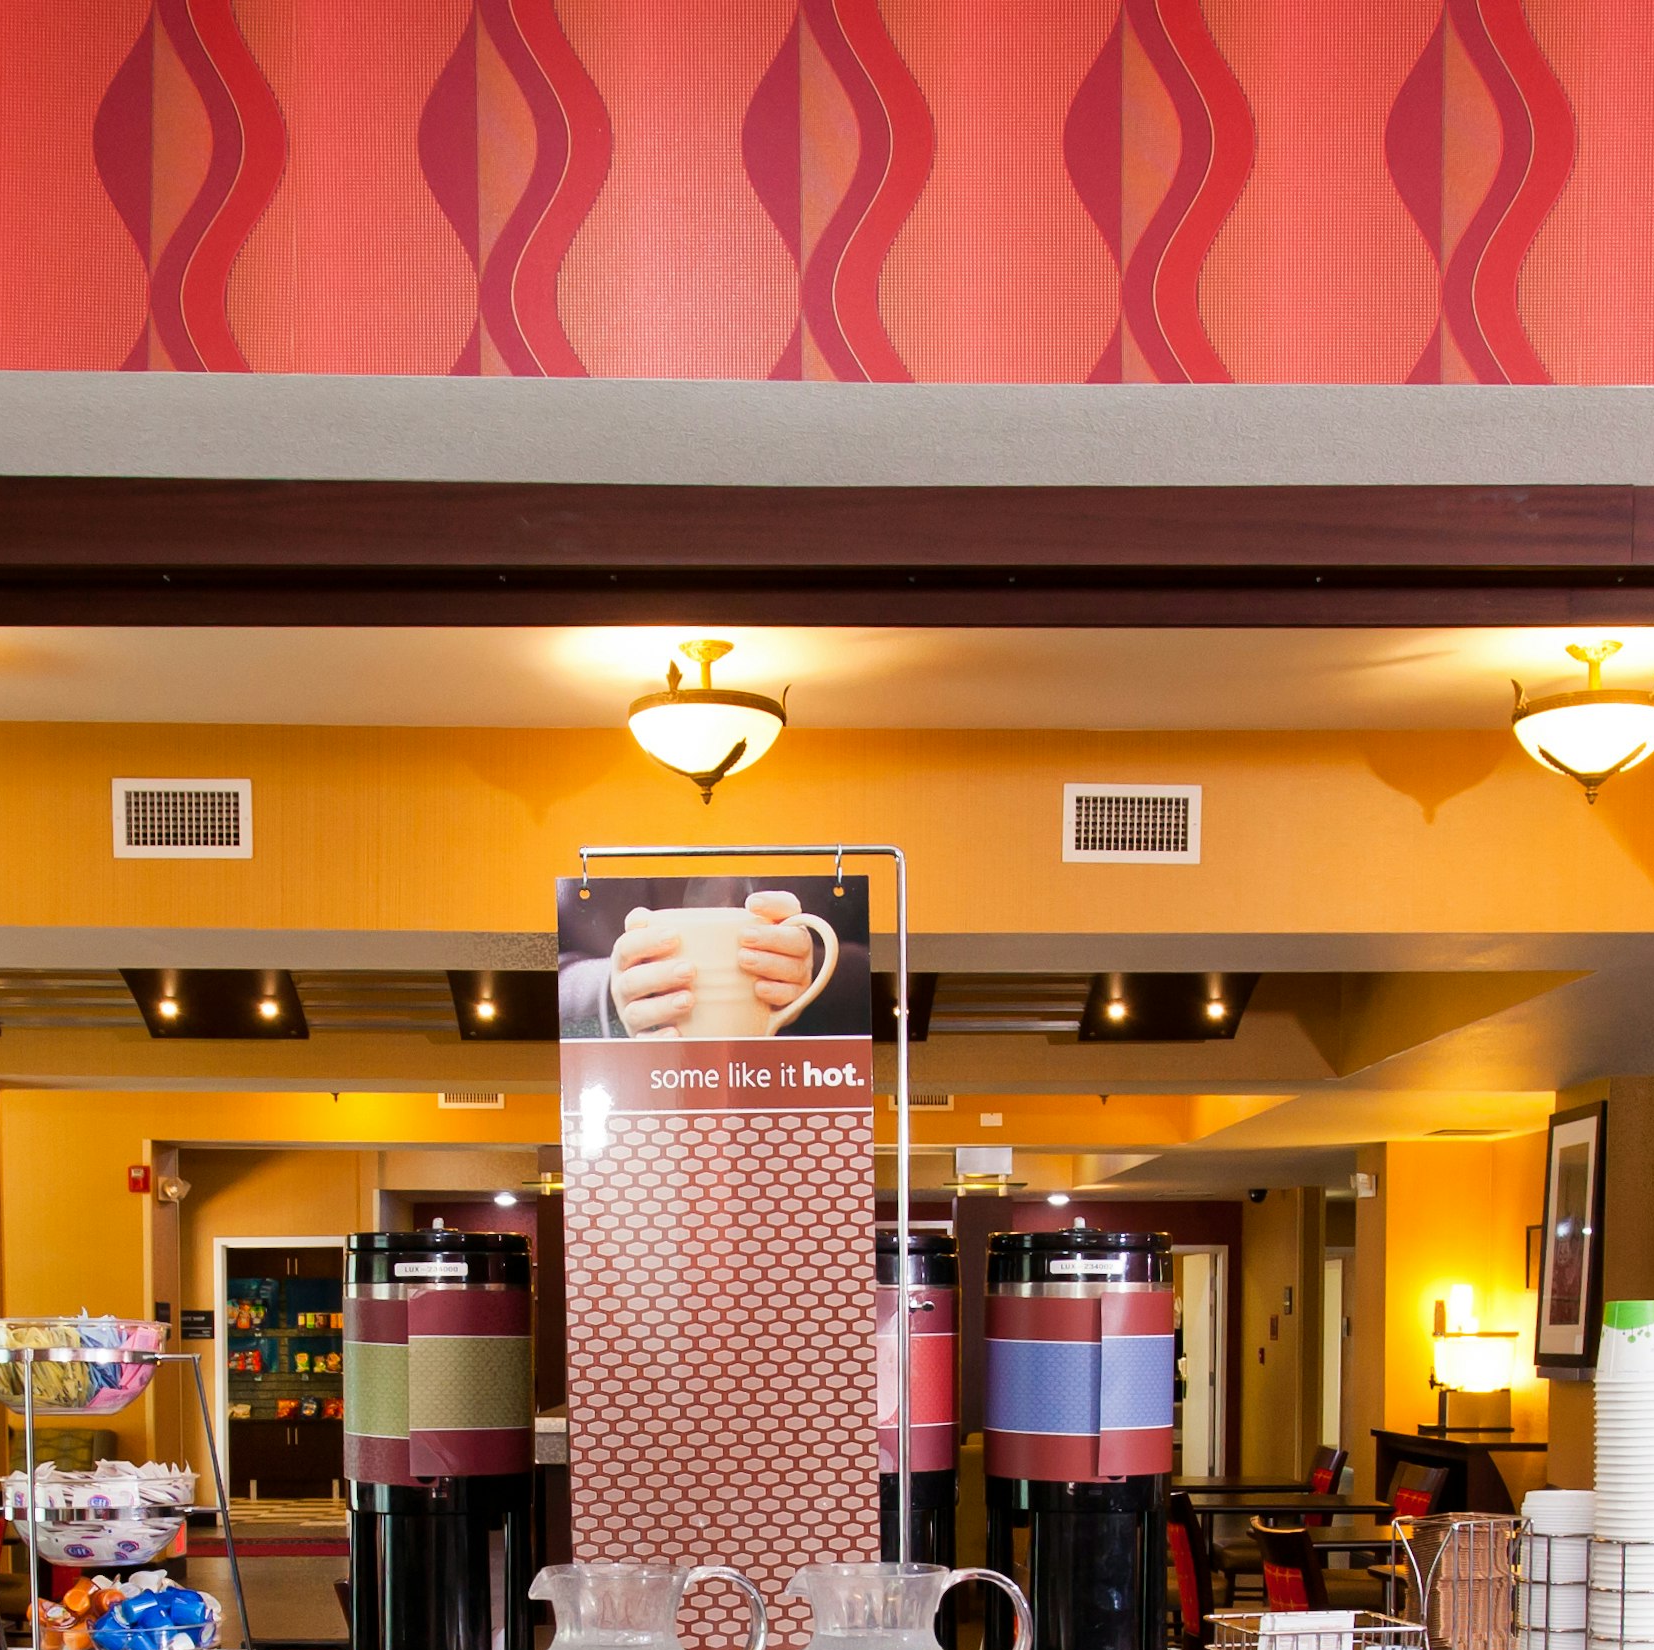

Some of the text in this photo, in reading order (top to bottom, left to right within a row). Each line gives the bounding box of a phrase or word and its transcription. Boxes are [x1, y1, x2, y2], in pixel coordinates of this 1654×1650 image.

[650, 1060, 865, 1089] some like it hot.
